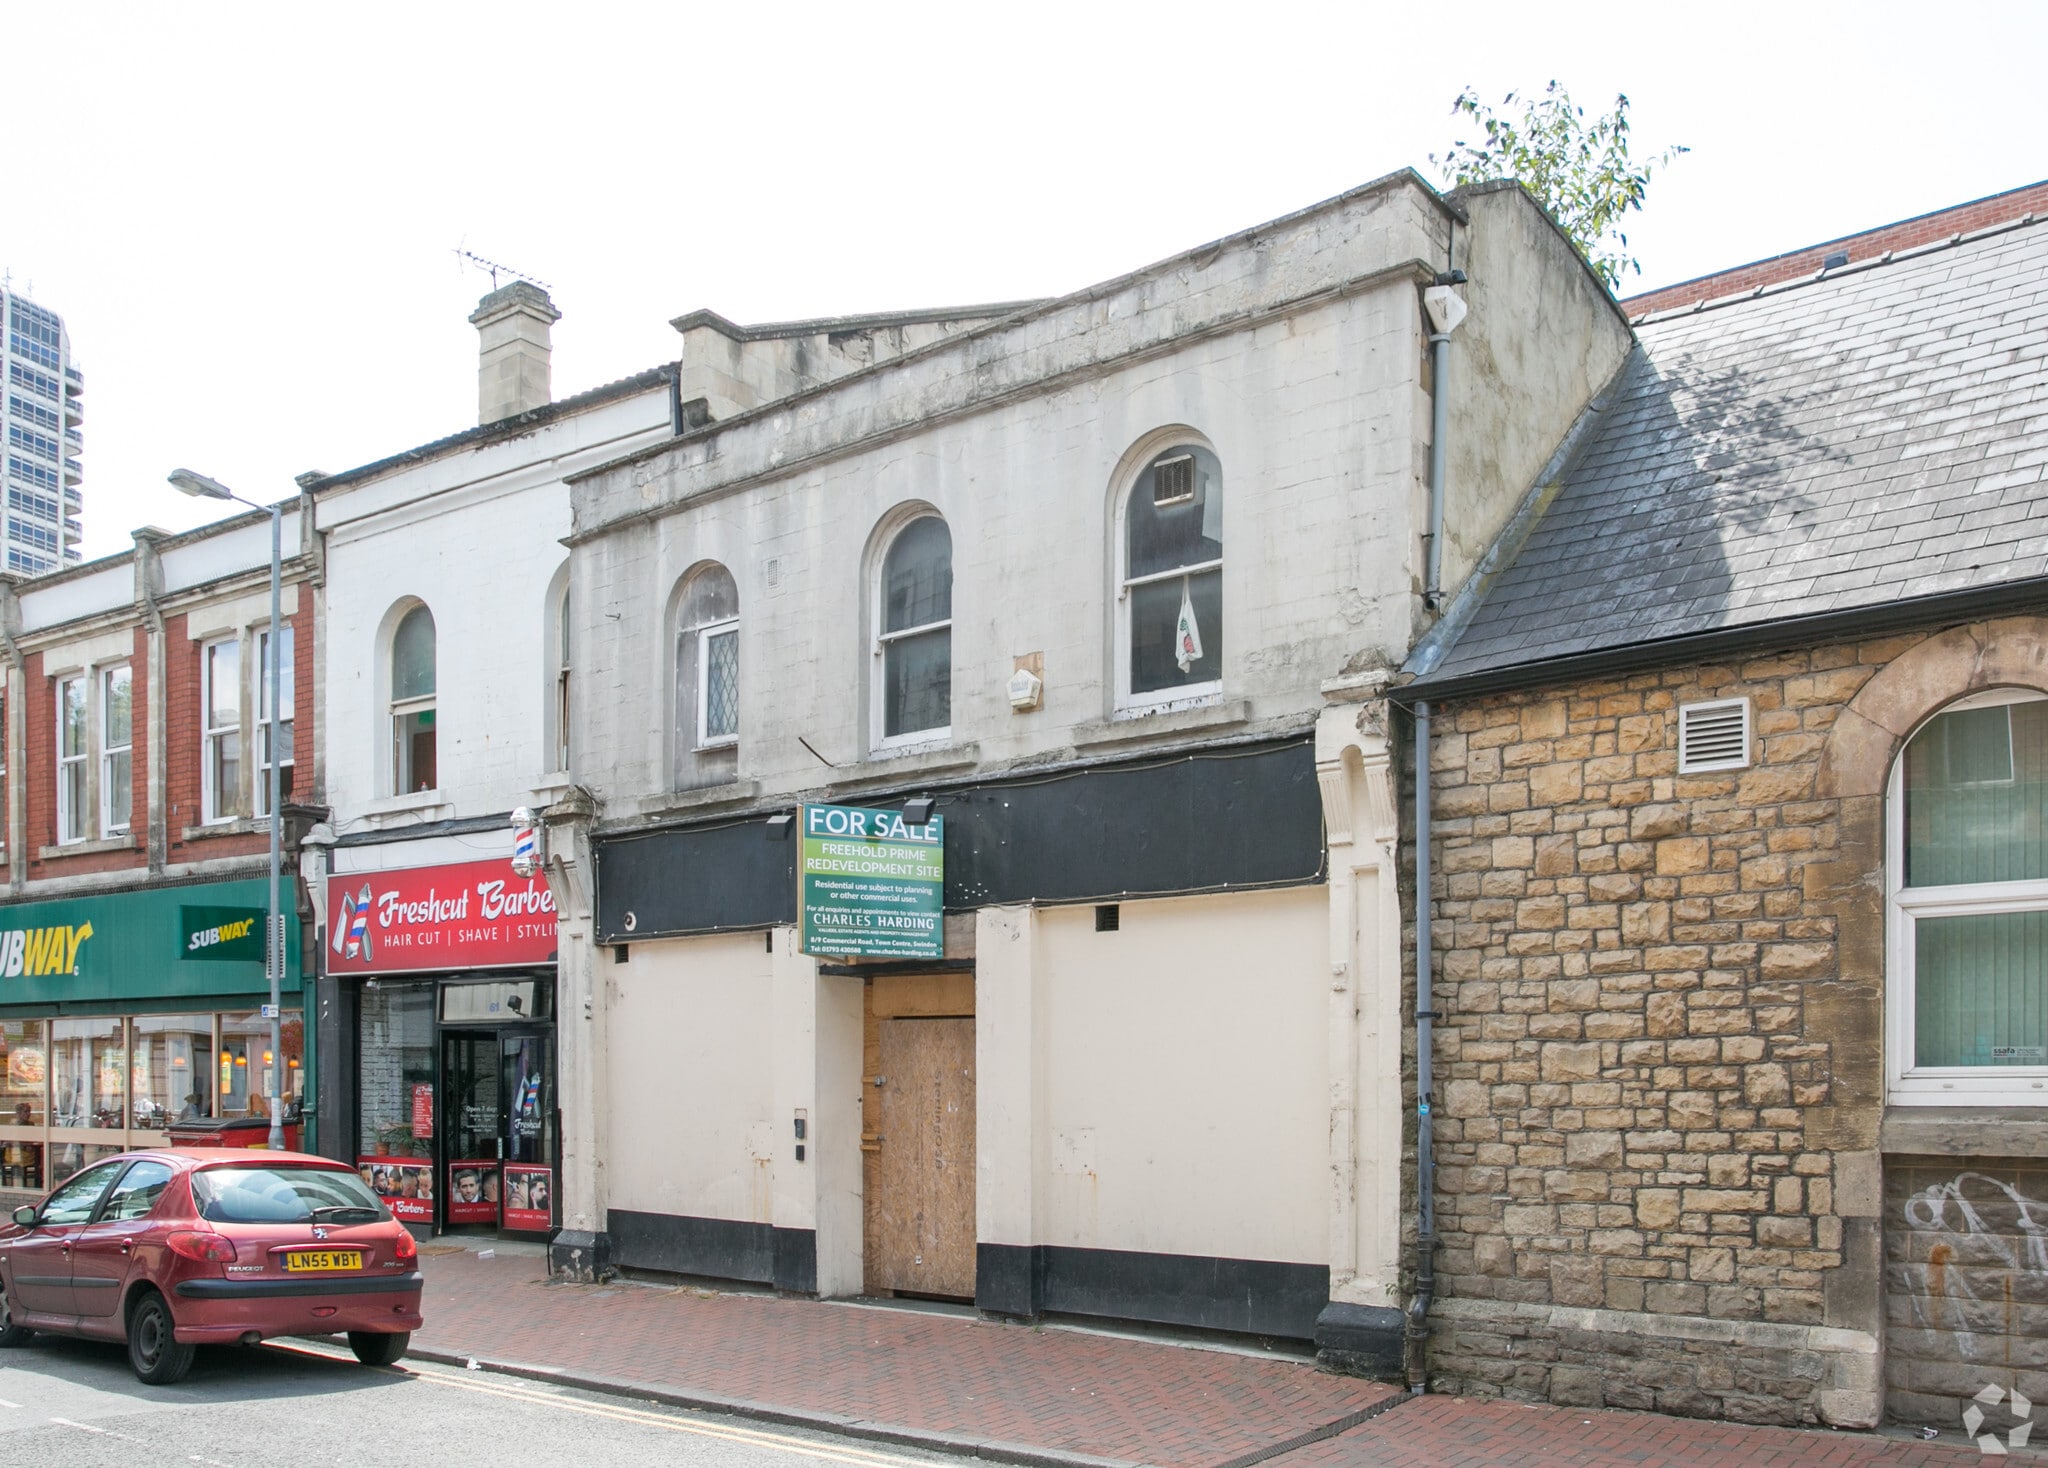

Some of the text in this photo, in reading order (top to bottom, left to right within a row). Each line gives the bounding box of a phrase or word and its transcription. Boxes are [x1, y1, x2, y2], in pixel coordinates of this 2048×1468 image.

[810, 808, 939, 841] FOR SALE
[822, 843, 927, 861] FREEHOLD PRIME
[807, 858, 940, 878] REDEVELOPMENT SITE
[815, 880, 933, 896] Residential use subject to planning
[840, 891, 859, 900] other
[860, 893, 900, 902] commercial
[901, 895, 918, 903] uses.
[378, 888, 469, 928] Freshcut
[825, 906, 851, 915] enquiries
[863, 908, 900, 917] appointments
[813, 913, 935, 930] CHARLES HARDING
[188, 918, 255, 951] SUBWAY
[384, 934, 412, 948] HAIR
[417, 931, 441, 945] CUT
[458, 927, 498, 943] SHAVE
[823, 937, 857, 945] Commercial
[396, 1200, 425, 1214] Barbers
[291, 1252, 358, 1268] LN55 WBT
[228, 1265, 264, 1273] PEUGEOT
